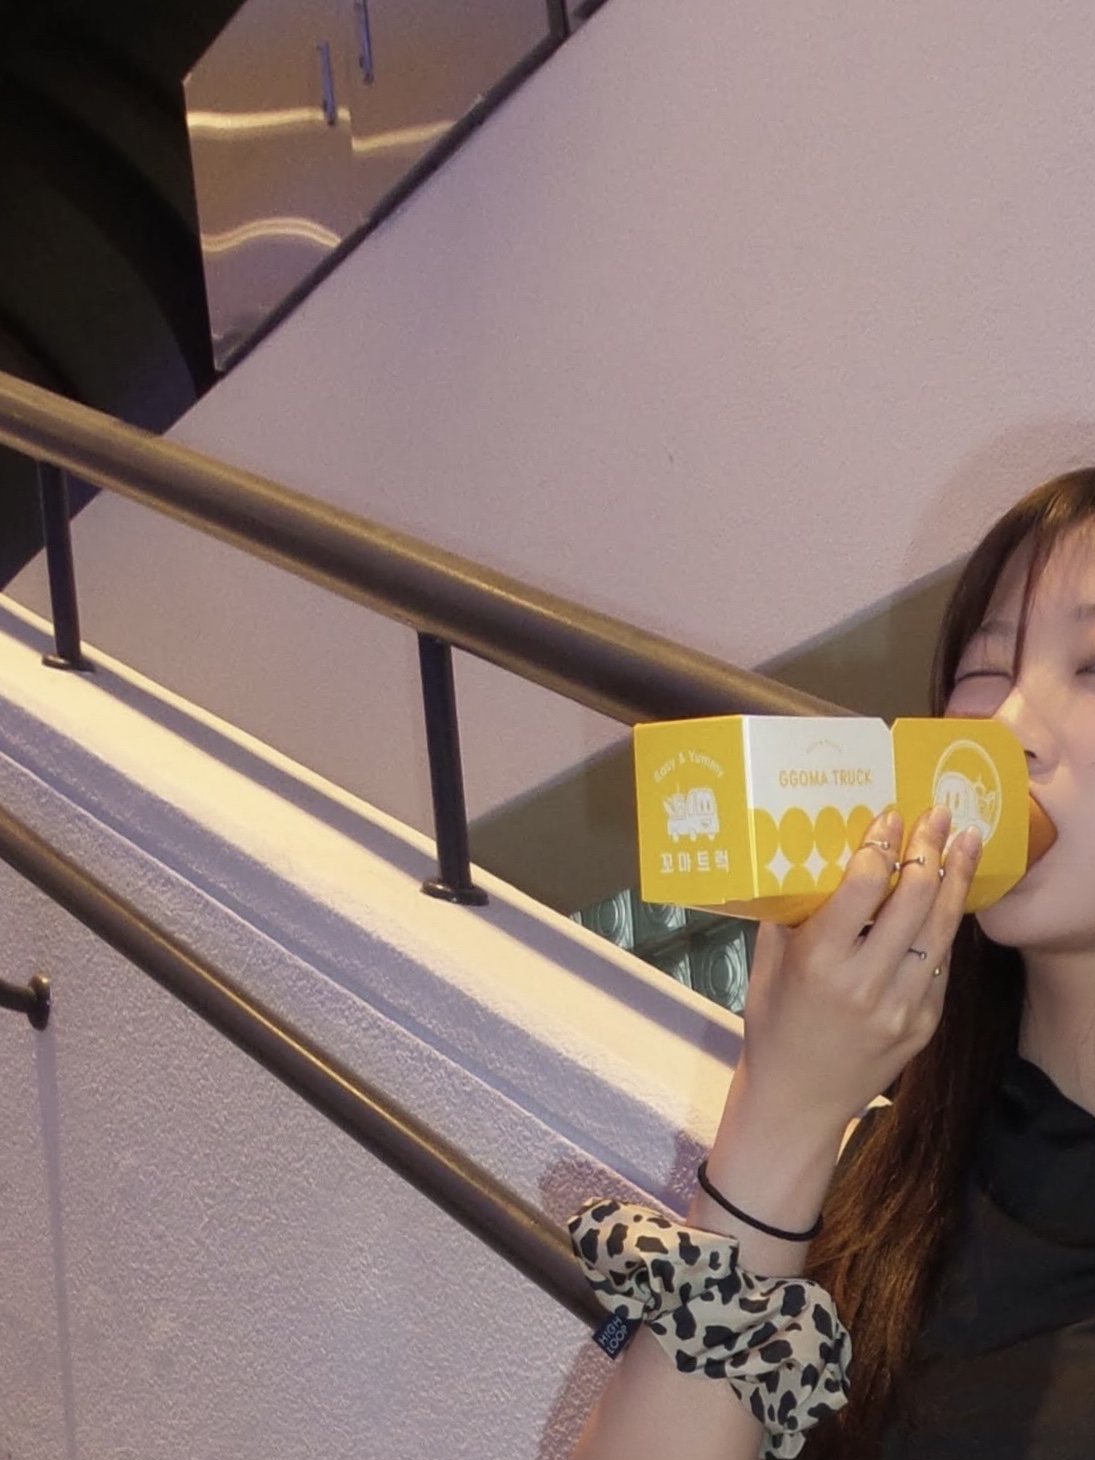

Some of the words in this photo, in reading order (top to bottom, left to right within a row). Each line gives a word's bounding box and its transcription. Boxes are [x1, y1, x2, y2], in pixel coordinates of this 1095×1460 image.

[688, 750, 724, 778] Yummy
[779, 769, 828, 787] GGOMA
[832, 767, 872, 786] TRUCK
[660, 849, 729, 873] 꼬마트럭
[598, 1316, 623, 1345] HIGH
[606, 1325, 628, 1354] LOOP
